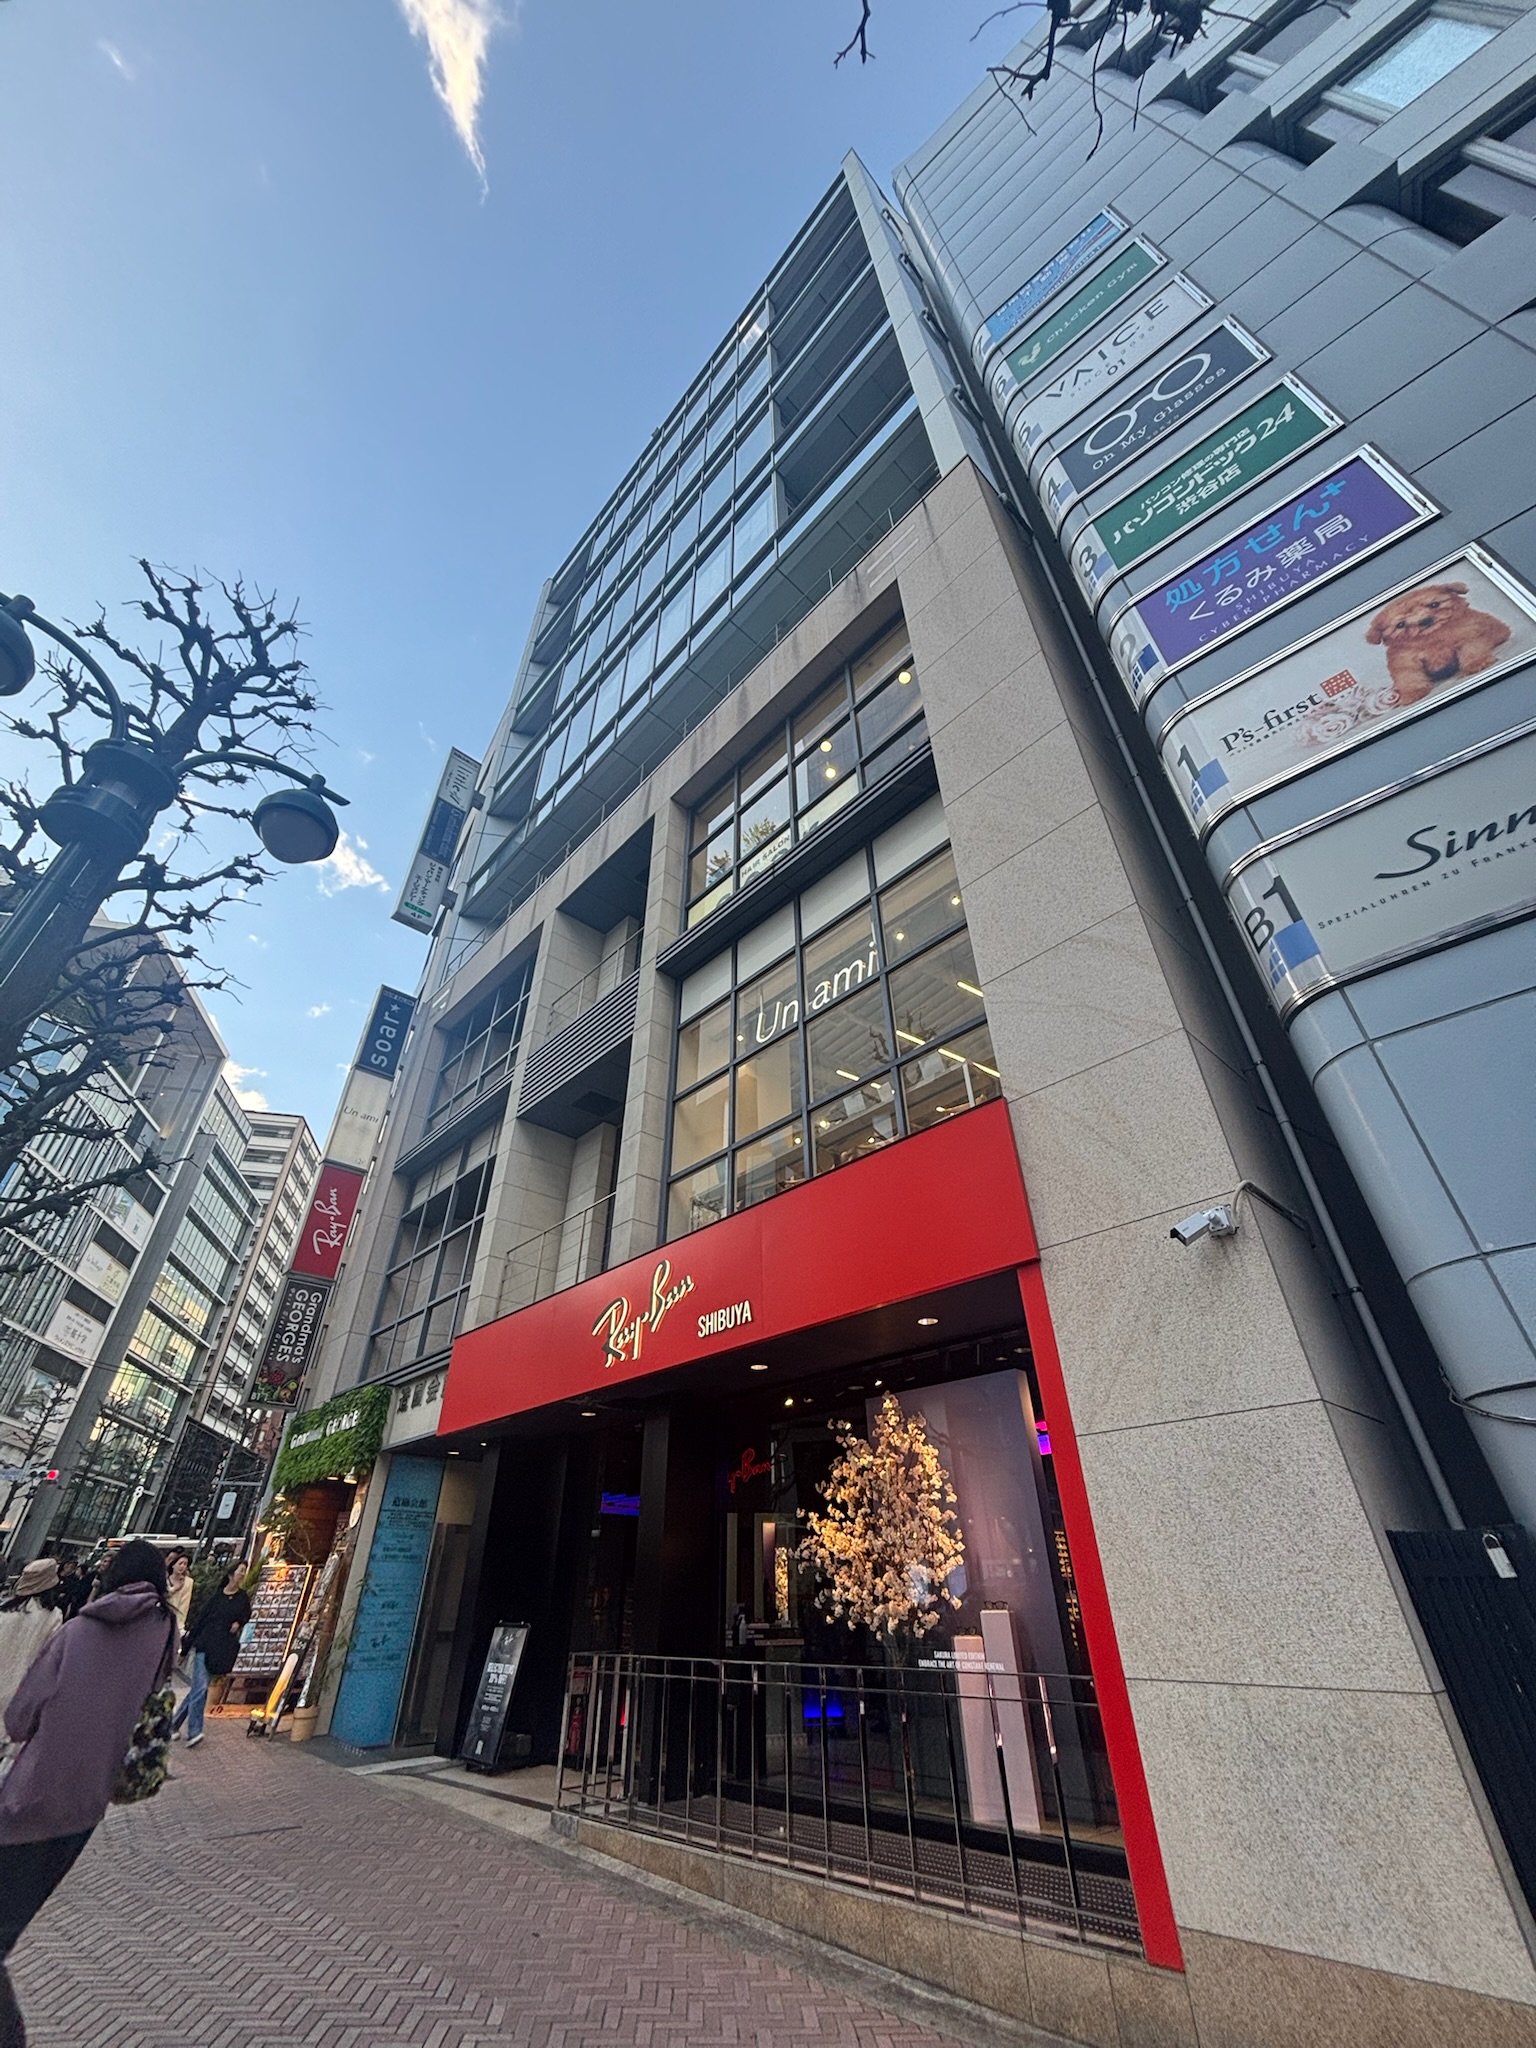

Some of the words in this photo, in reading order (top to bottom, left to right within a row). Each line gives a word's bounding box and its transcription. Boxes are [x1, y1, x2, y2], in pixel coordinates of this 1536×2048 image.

[1092, 452, 1116, 470] Oh
[1120, 425, 1148, 450] My
[1153, 367, 1227, 423] Glasses
[1175, 463, 1243, 515] 渋谷店
[1079, 545, 1098, 575] 3
[1188, 514, 1353, 622] くるみ薬局
[1198, 607, 1252, 642] CYBER
[1262, 534, 1370, 604] PHARMACY
[1235, 560, 1316, 610] SHIBUYA
[1117, 633, 1144, 671] 2
[1177, 744, 1201, 781] 1
[741, 859, 762, 879] HAIR
[762, 834, 790, 865] SALON
[1373, 803, 1536, 880] Sinn
[1244, 874, 1303, 955] B1
[756, 1000, 799, 1043] Un
[812, 941, 877, 1010] ami
[370, 1010, 401, 1068] soar
[275, 1289, 309, 1363] GEORGES
[291, 1291, 323, 1364] Grandma's
[697, 1300, 753, 1338] SHIBUYA
